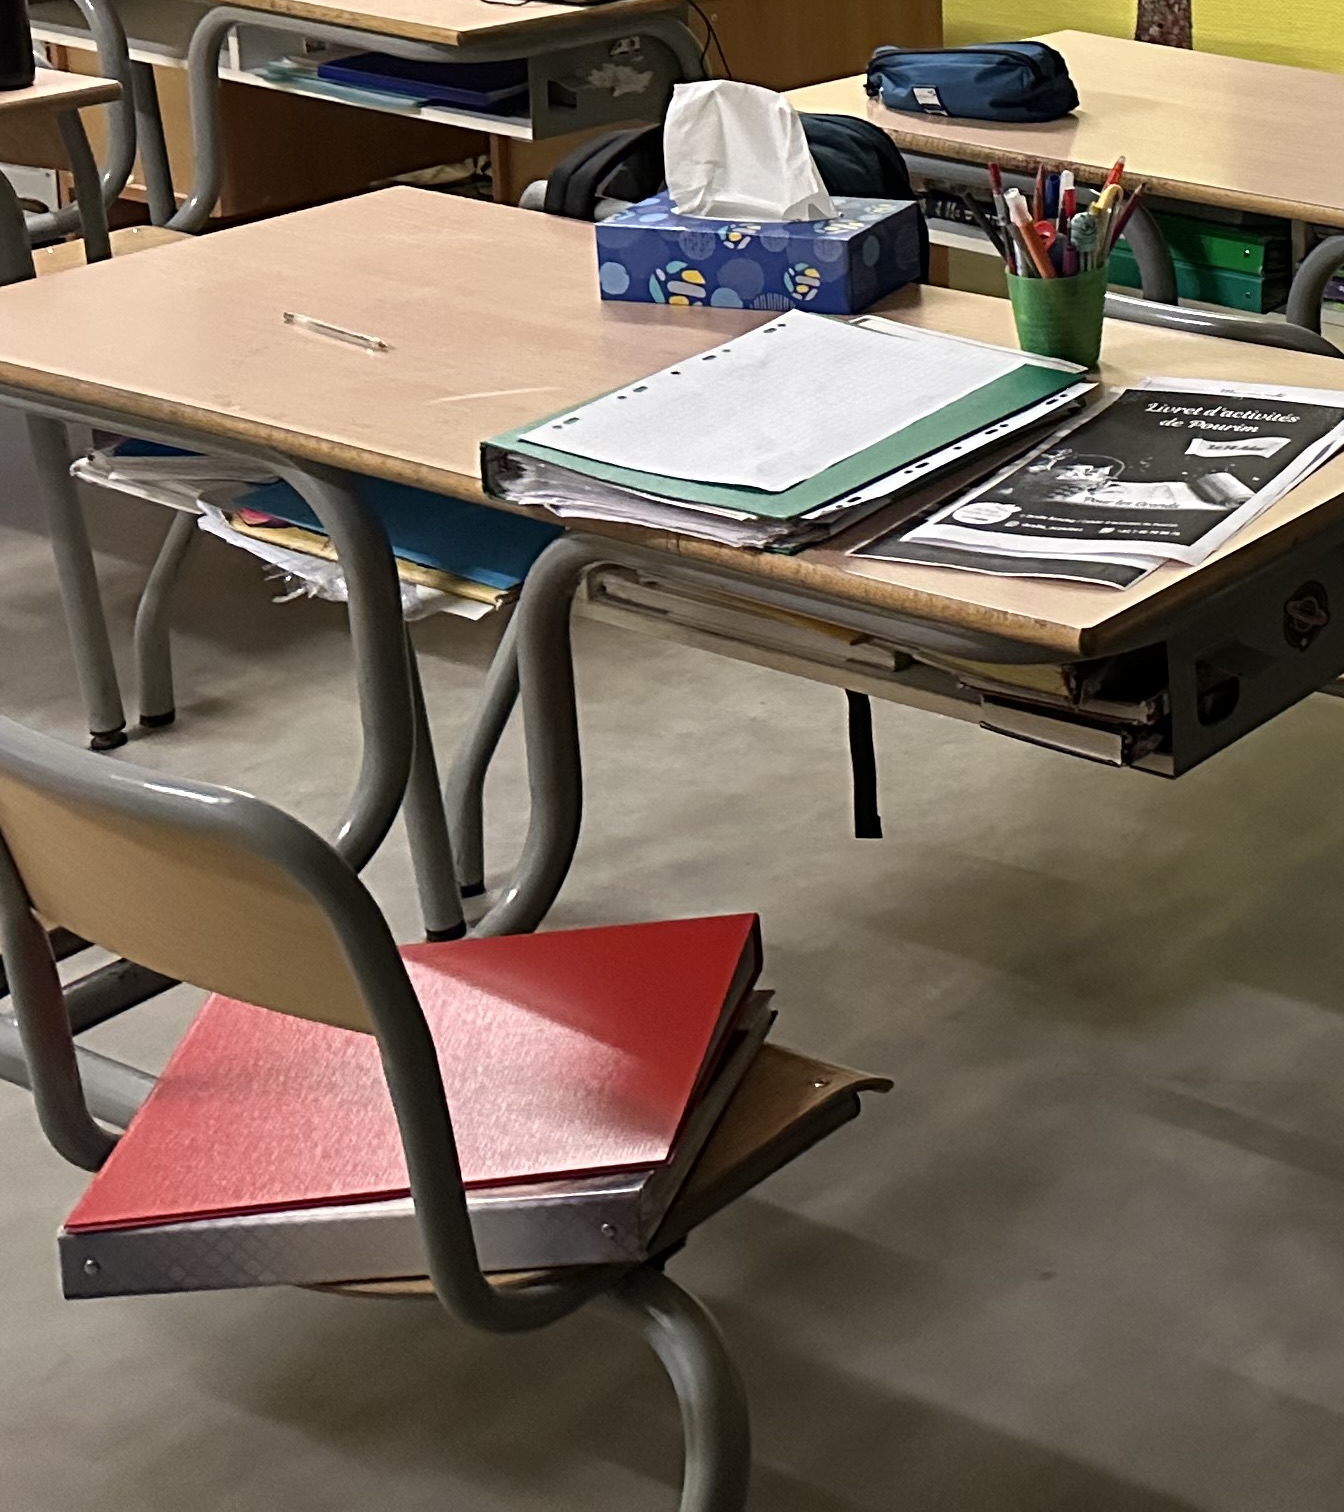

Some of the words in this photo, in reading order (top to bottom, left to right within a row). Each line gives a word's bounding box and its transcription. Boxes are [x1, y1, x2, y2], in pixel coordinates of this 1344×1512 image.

[1144, 401, 1204, 418] Livret
[1204, 403, 1301, 424] d'activités
[1159, 416, 1183, 429] de
[1186, 418, 1259, 434] Pourim
